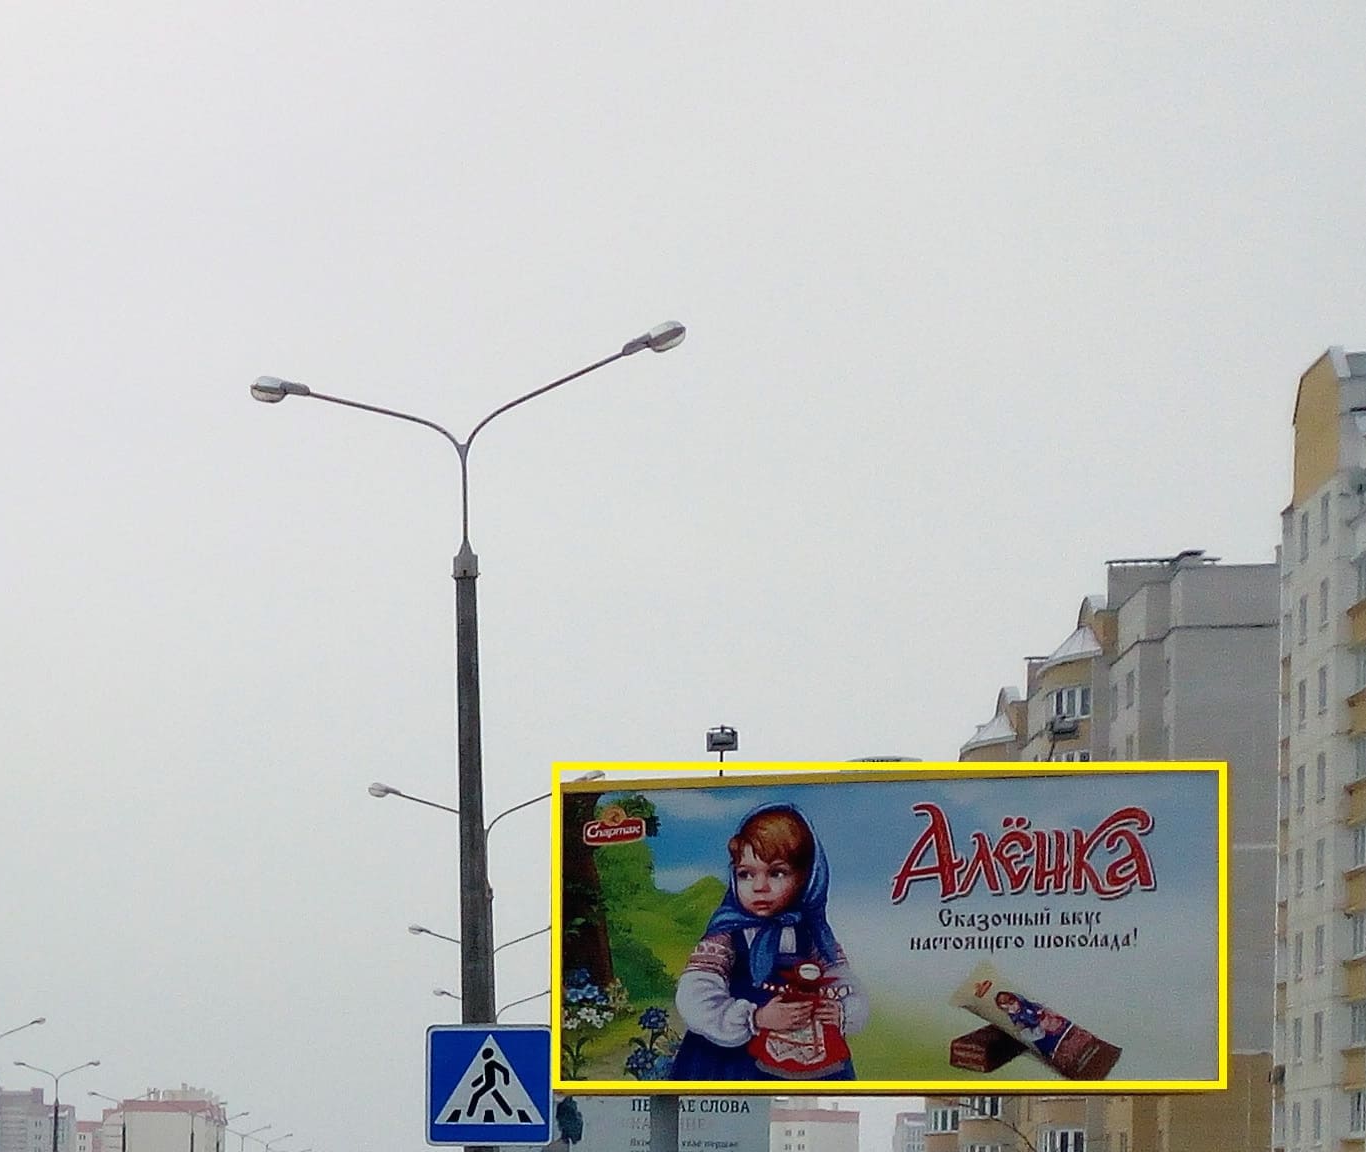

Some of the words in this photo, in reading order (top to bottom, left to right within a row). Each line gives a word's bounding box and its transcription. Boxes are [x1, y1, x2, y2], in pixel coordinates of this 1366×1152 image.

[587, 823, 641, 840] Спартак
[891, 802, 1156, 903] Алёнка
[938, 907, 1050, 931] Сказочный
[1060, 911, 1101, 934] вкус
[910, 935, 1025, 953] настоящего
[1034, 927, 1138, 951] шоколада!
[632, 1098, 695, 1112] ПЕАЕ
[700, 1099, 750, 1113] СЛОВА
